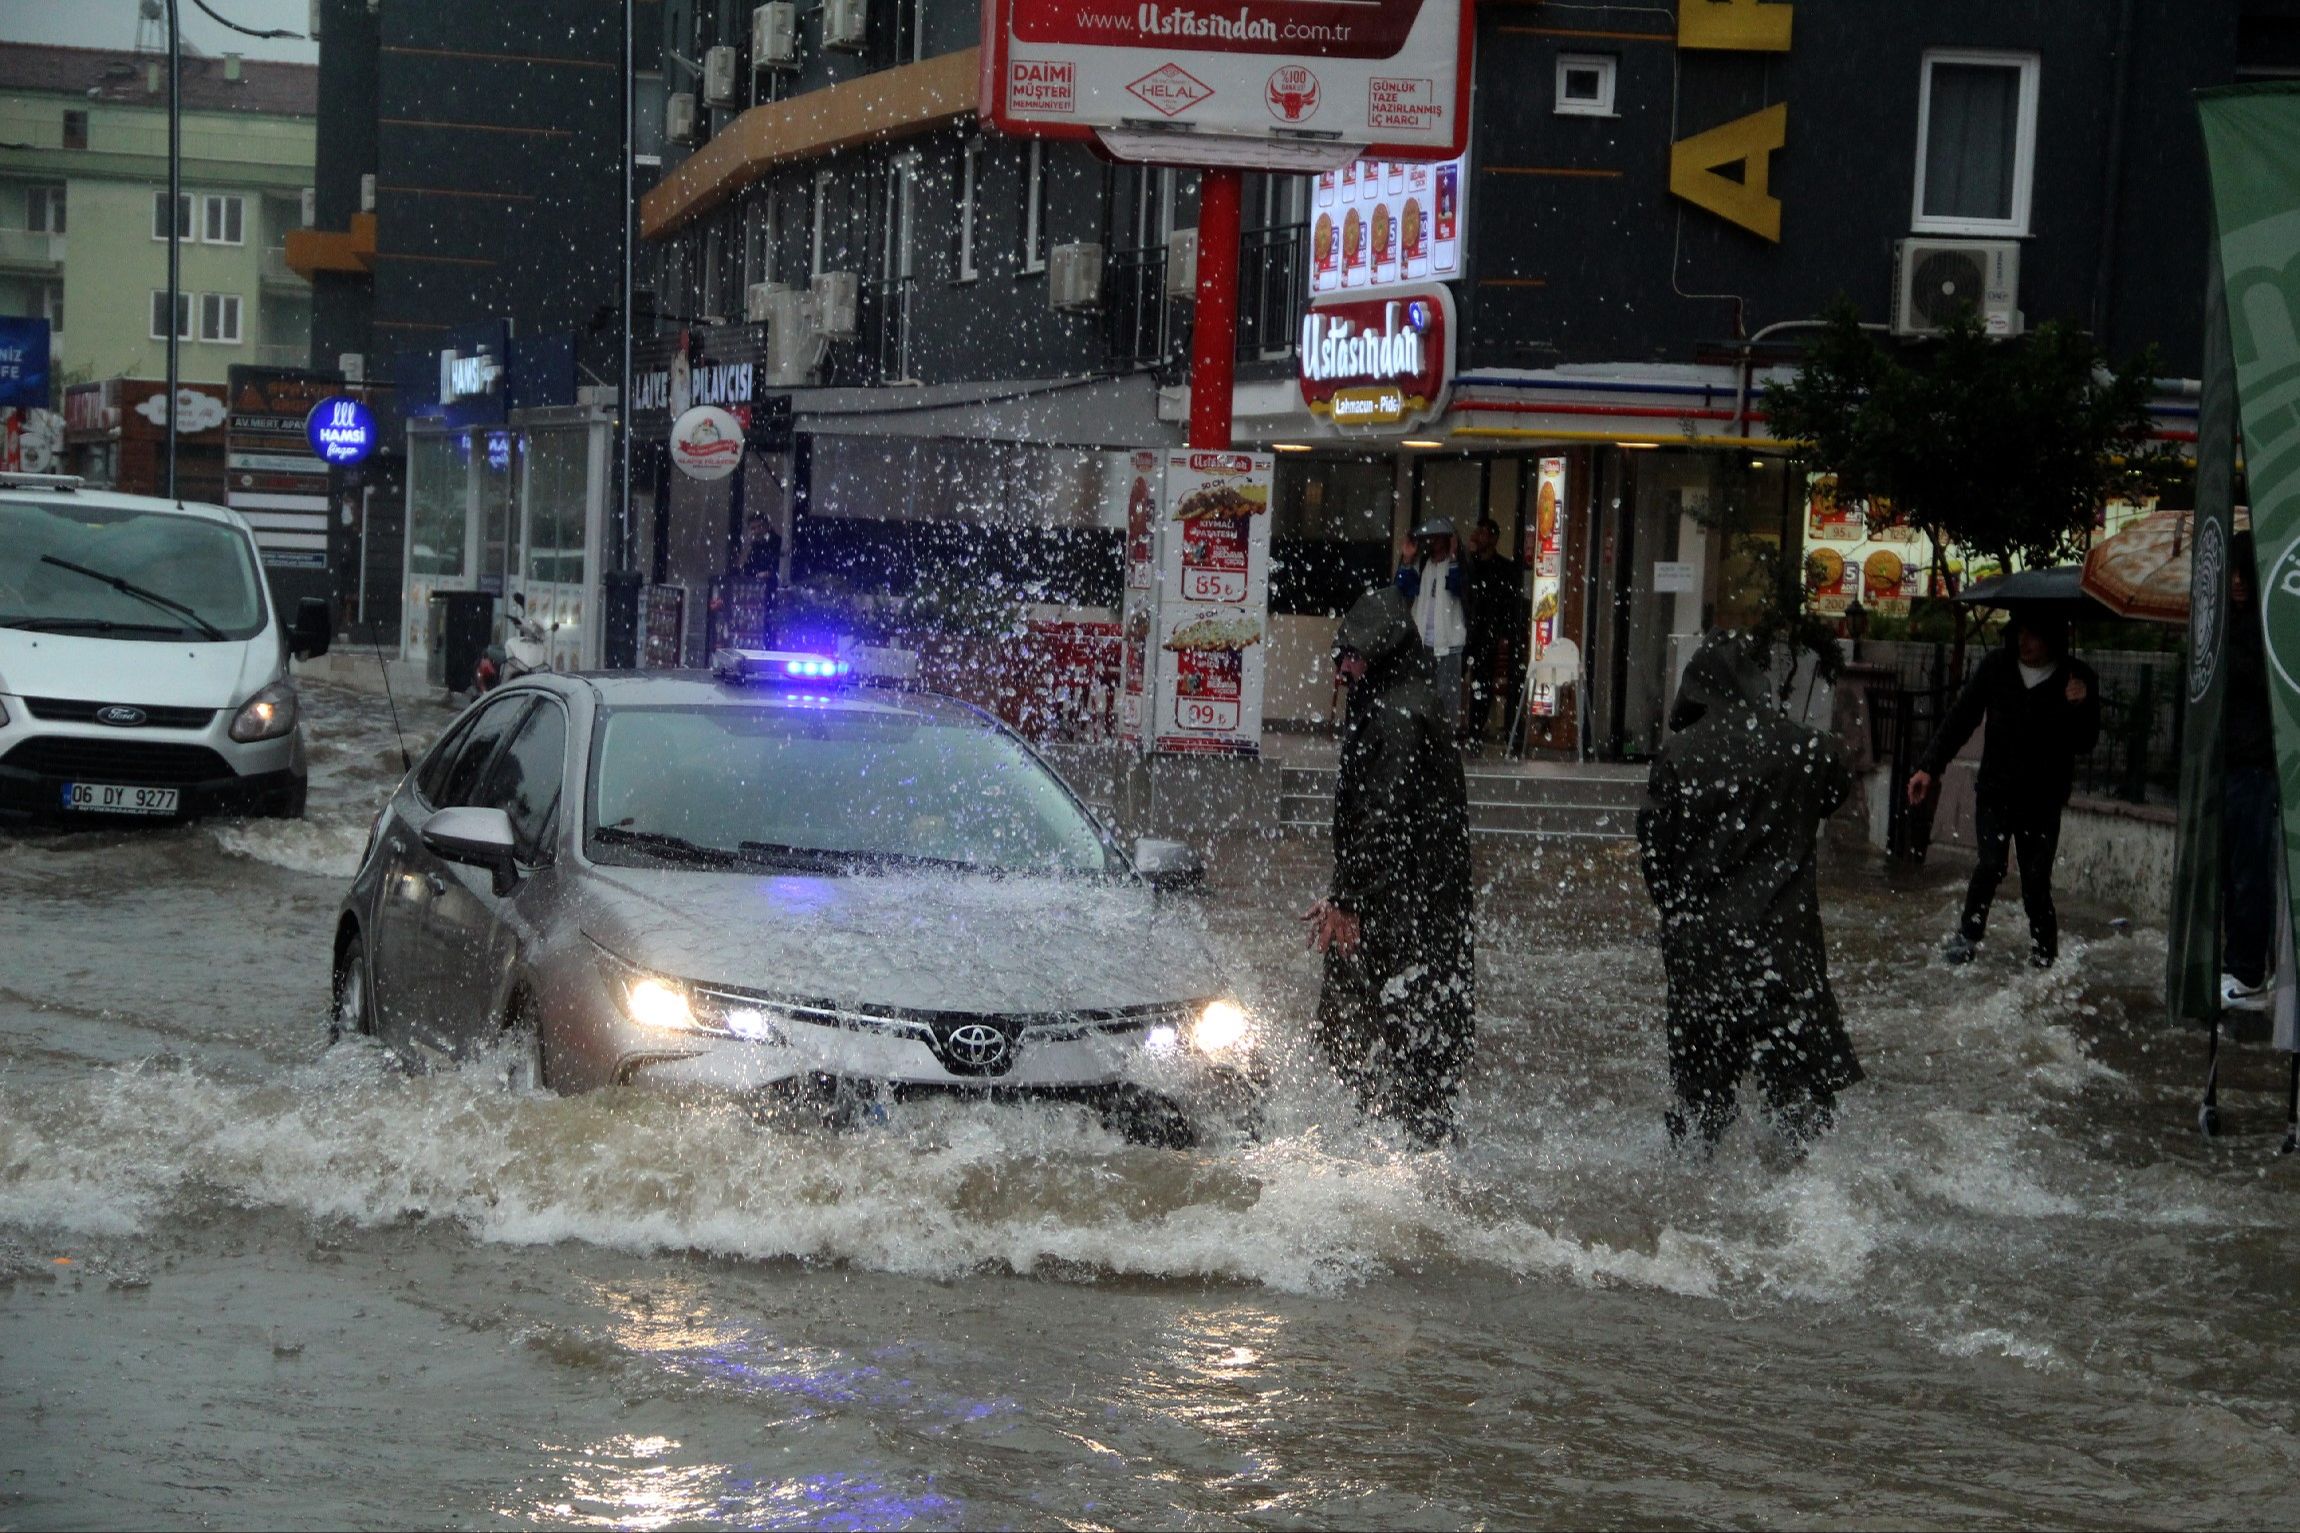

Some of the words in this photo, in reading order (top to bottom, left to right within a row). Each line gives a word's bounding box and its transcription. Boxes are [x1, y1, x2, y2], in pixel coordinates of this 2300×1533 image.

[1013, 61, 1073, 82] DAİMİ
[1013, 83, 1071, 99] MÜŞTERİ
[1142, 84, 1198, 99] HELAL
[1373, 80, 1415, 93] GÜNLÜK
[1372, 93, 1398, 102] TAZE
[1335, 397, 1373, 415] Lahmacun
[320, 426, 366, 443] HAMSİ
[1846, 566, 1855, 579] 5
[108, 708, 136, 720] Ford
[73, 785, 92, 803] 06
[104, 787, 123, 805] DY
[136, 789, 175, 808] 9277
